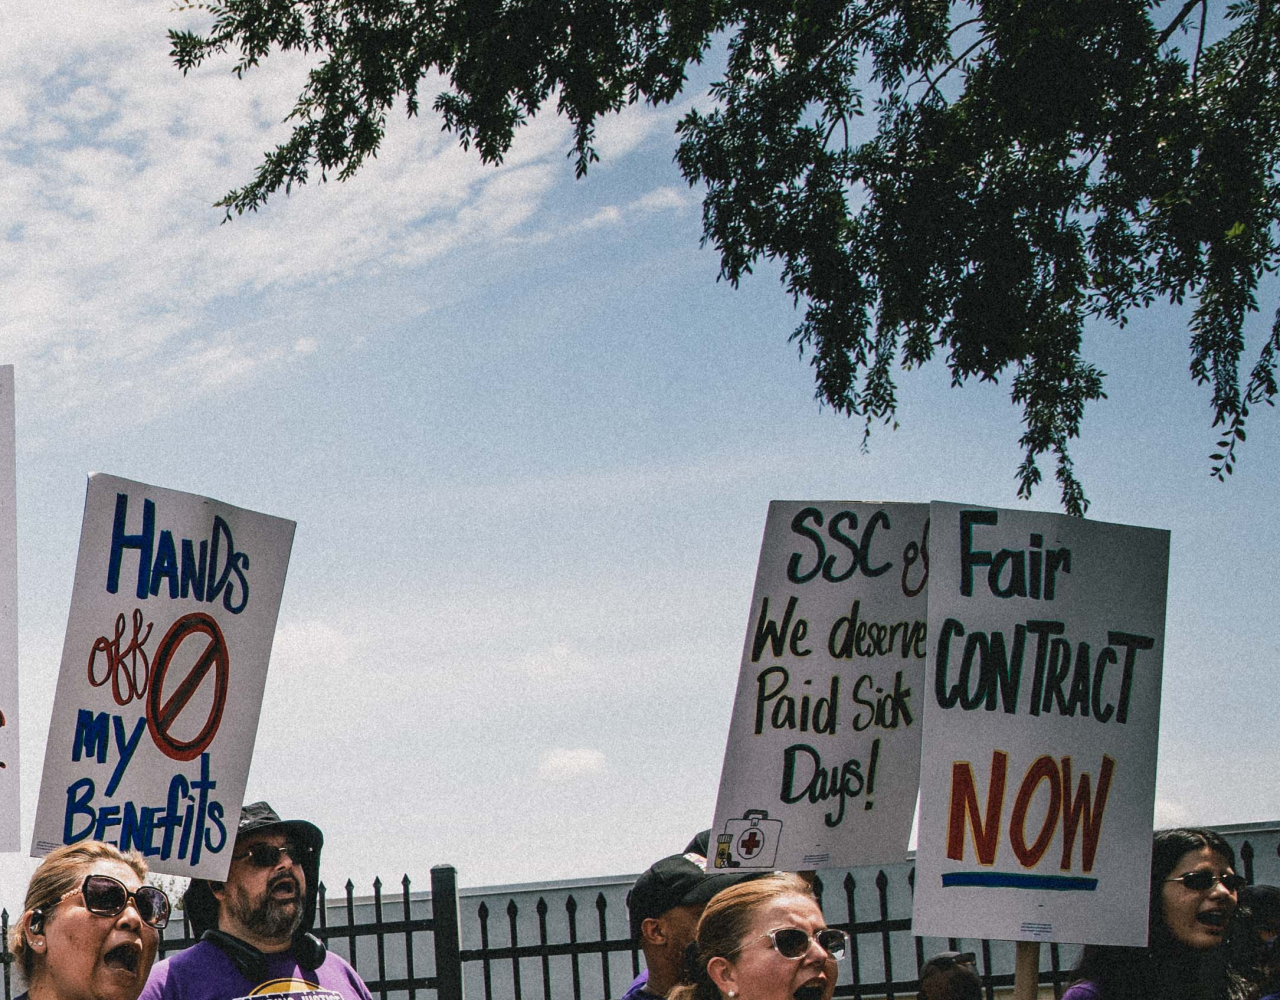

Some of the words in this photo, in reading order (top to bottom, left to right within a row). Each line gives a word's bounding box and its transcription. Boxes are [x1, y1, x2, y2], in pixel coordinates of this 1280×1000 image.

[787, 506, 893, 585] SSC
[958, 510, 1072, 600] Fair
[87, 608, 154, 706] off
[751, 596, 812, 663] We
[828, 600, 928, 660] deserve
[934, 618, 1155, 724] CONTRACT
[754, 665, 841, 735] Paid
[852, 670, 914, 733] Sick
[780, 739, 881, 828] Days!
[946, 749, 1117, 874] NOW
